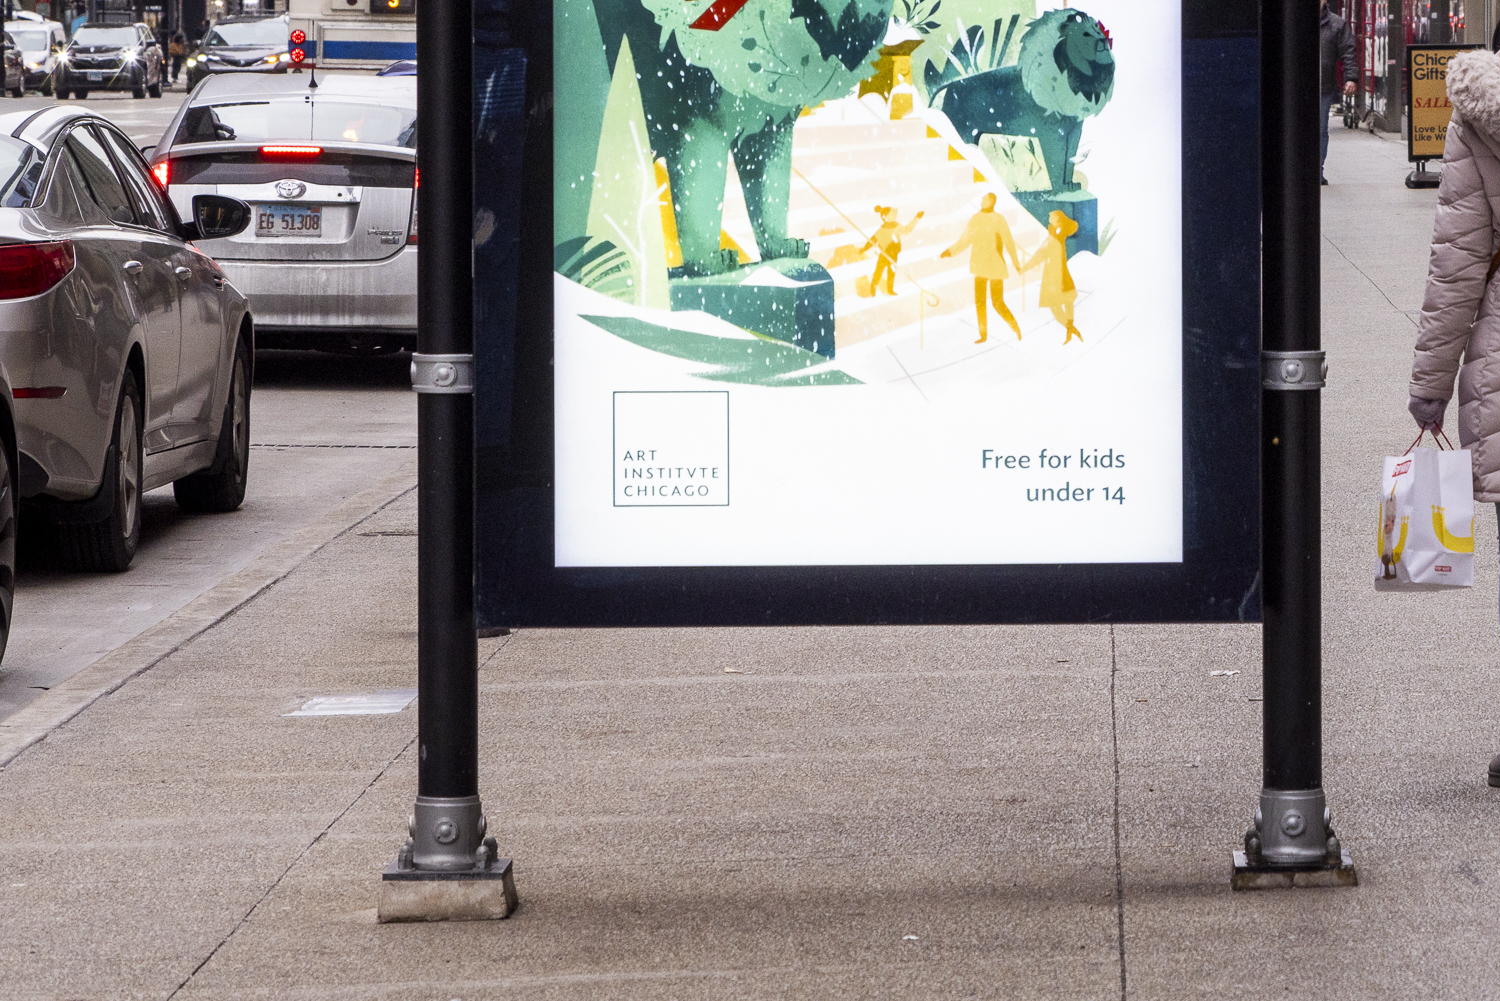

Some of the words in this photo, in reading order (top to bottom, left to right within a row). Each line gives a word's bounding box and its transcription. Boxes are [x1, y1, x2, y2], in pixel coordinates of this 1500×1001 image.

[1413, 53, 1456, 66] Chic
[1413, 67, 1446, 80] Gifts
[1413, 97, 1452, 108] SALE
[1414, 125, 1435, 133] Love
[1414, 133, 1432, 141] Like
[259, 213, 275, 230] EG
[281, 213, 320, 230] 51308
[623, 450, 657, 461] ART
[982, 449, 1030, 469] Free
[1039, 448, 1072, 469] for
[1080, 448, 1126, 469] kids
[624, 467, 719, 479] INSTITVTE
[624, 485, 709, 497] CHICAGO
[1026, 481, 1095, 502] under
[1102, 486, 1126, 505] 14
